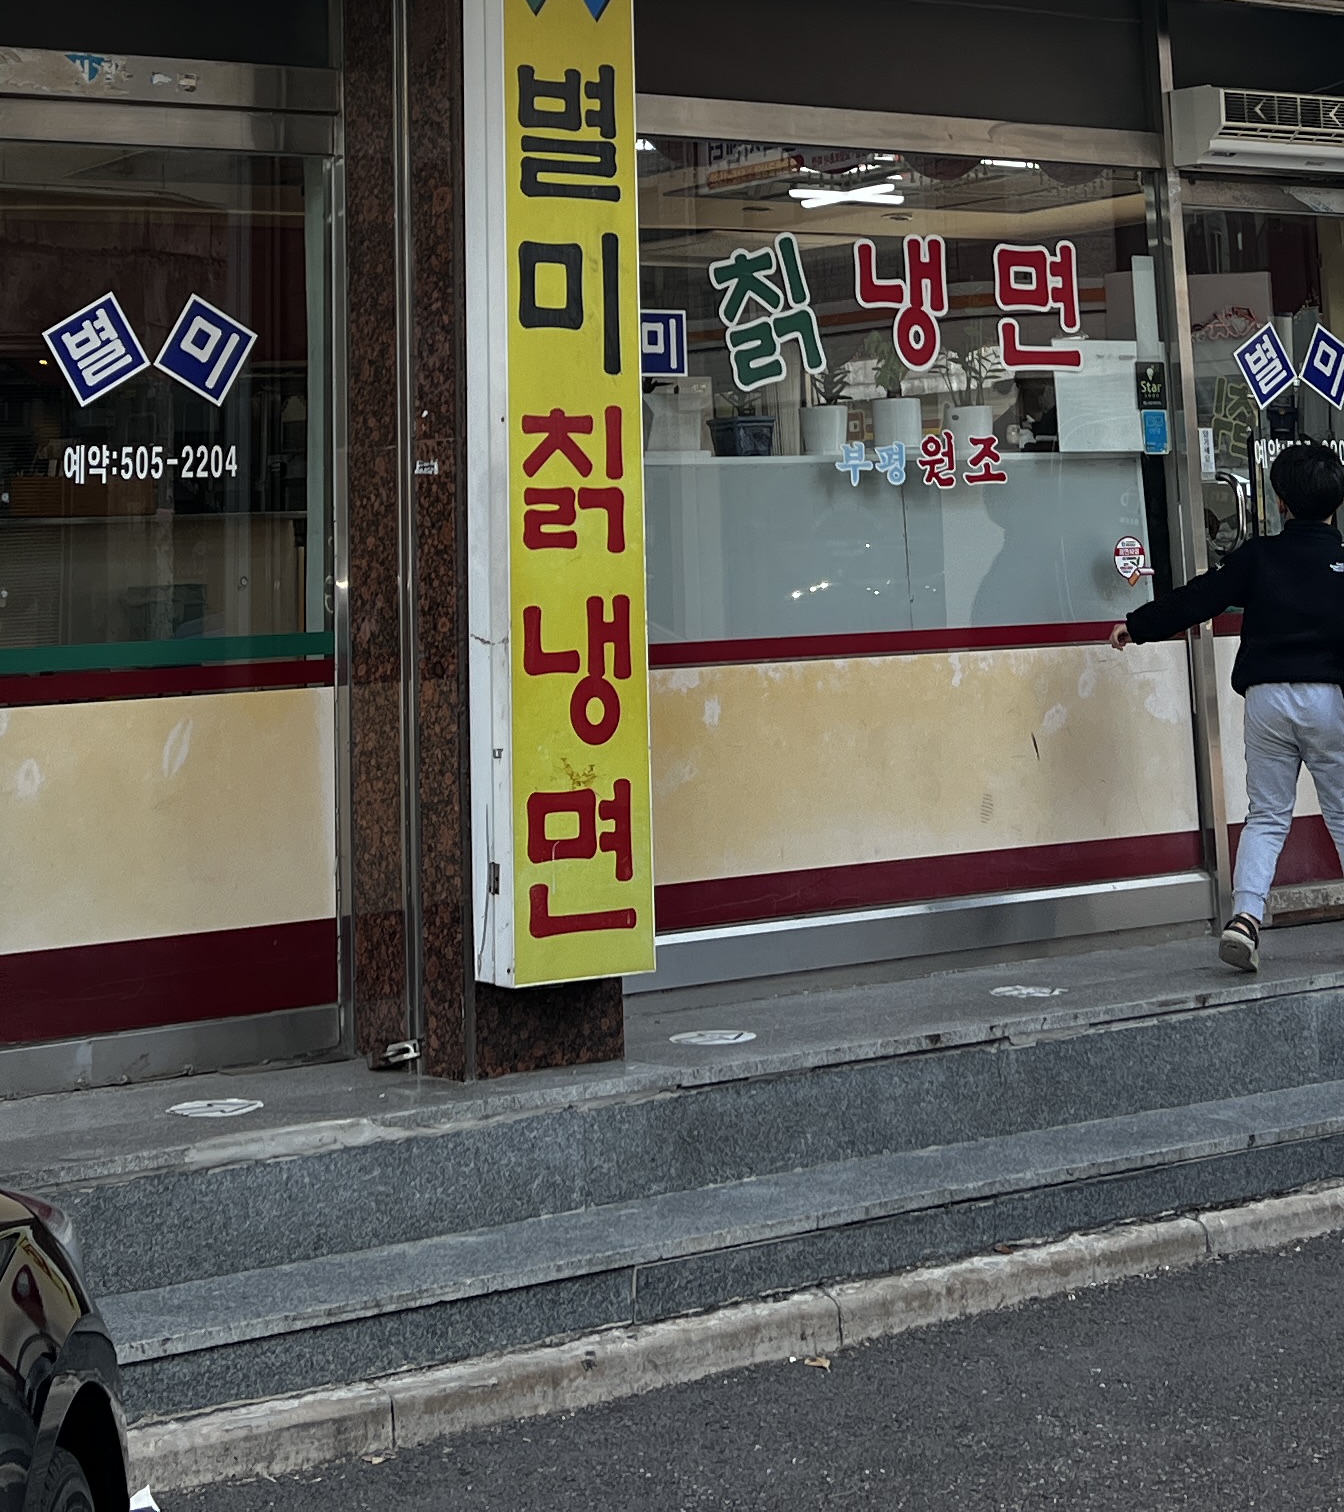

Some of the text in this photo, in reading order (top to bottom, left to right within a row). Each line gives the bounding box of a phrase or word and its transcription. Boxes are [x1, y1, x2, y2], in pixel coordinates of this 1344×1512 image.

[62, 310, 238, 391] 별미
[709, 232, 1084, 391] 칡냉면
[63, 443, 238, 486] 예약:505-2204
[837, 430, 1009, 488] 부평 원조
[517, 64, 637, 938] 별미 칡냉면
